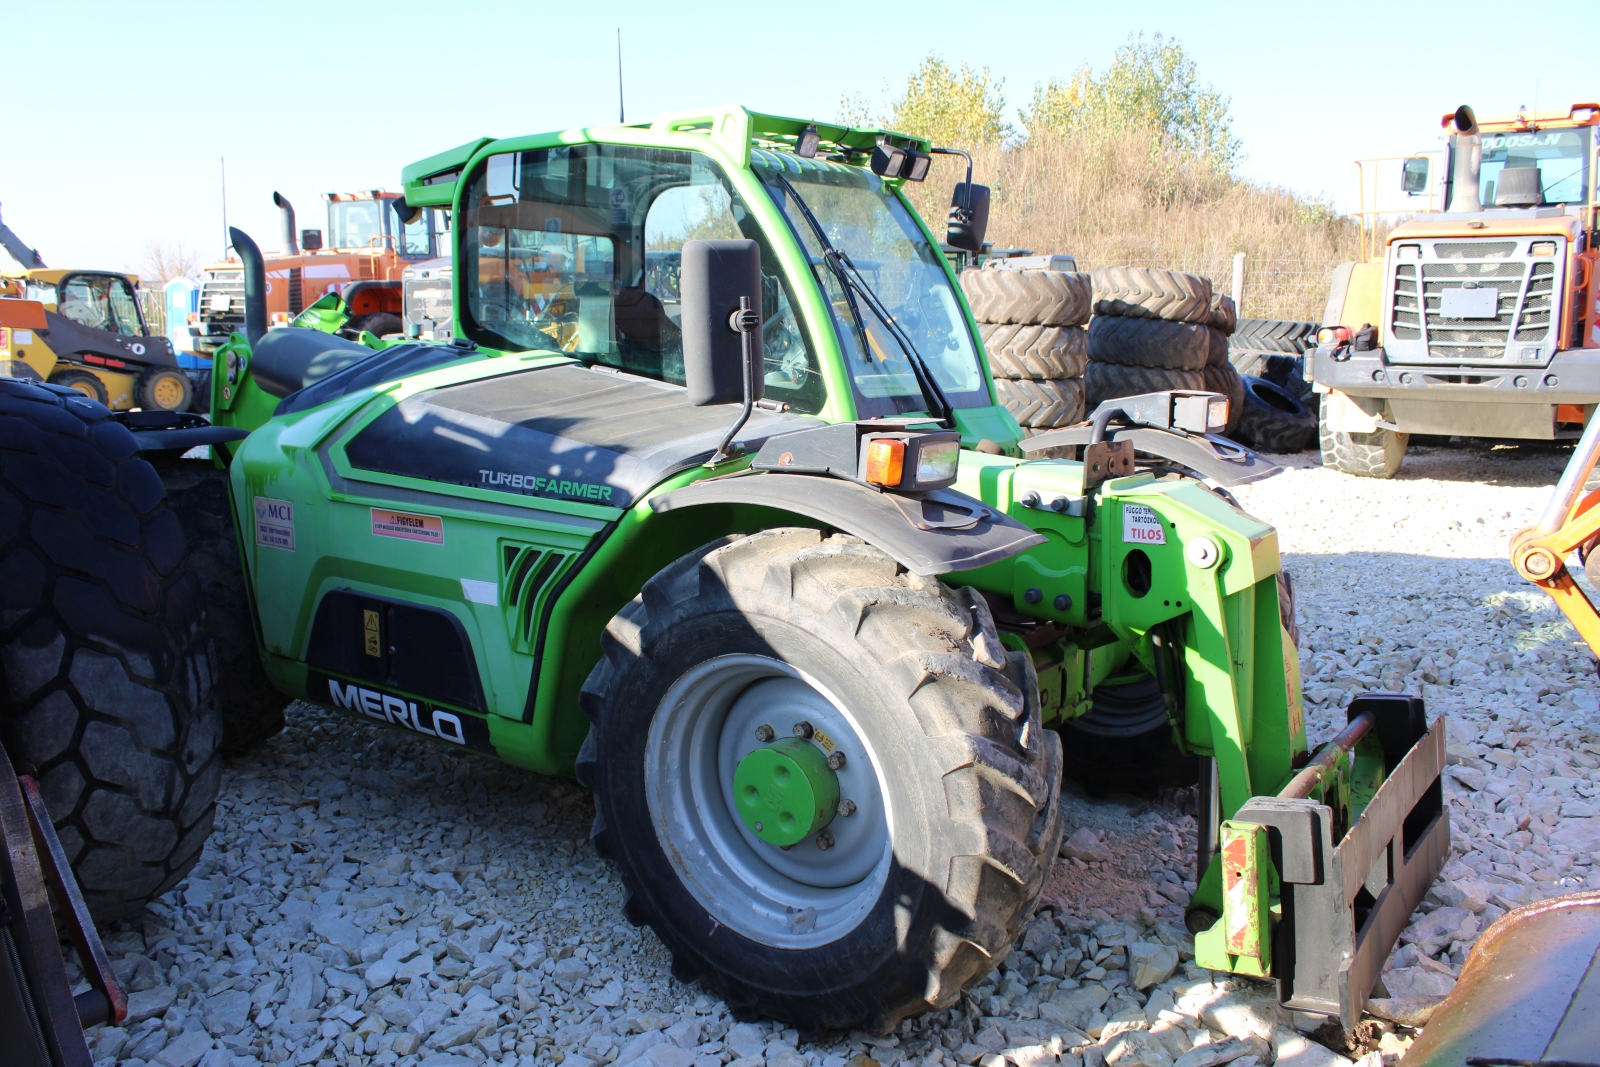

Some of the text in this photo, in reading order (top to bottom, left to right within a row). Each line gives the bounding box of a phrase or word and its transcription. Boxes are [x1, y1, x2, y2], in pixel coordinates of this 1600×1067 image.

[1481, 134, 1562, 148] DOOSAN
[479, 469, 612, 501] TURBOFARMER
[1131, 528, 1161, 540] TILOS
[328, 679, 466, 745] MERLO
